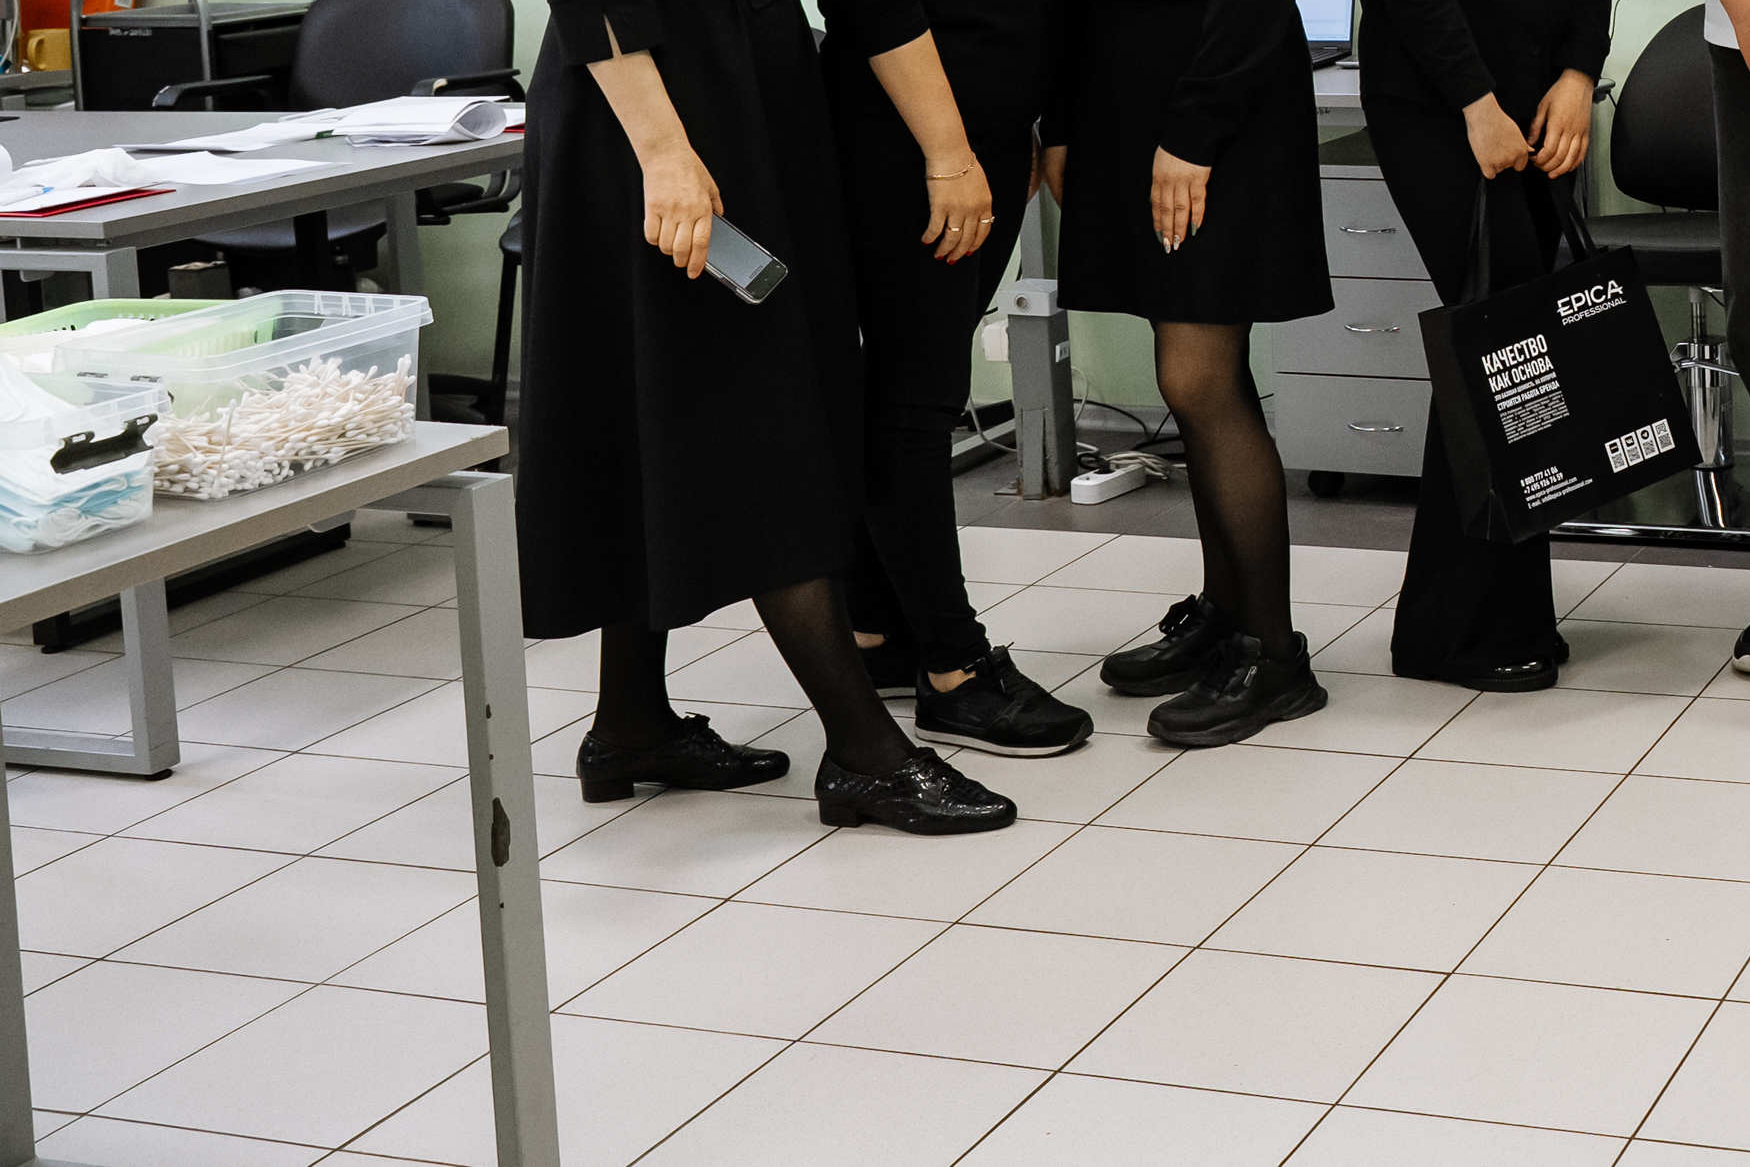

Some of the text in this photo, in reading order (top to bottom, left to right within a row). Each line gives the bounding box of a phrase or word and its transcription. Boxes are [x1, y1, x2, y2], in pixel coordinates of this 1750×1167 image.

[1556, 279, 1624, 317] EPICA
[1561, 296, 1627, 326] PROFESSIONAL
[1481, 334, 1548, 375] КАЧЕСТВО
[1488, 355, 1554, 393] КАК ОСНОВА
